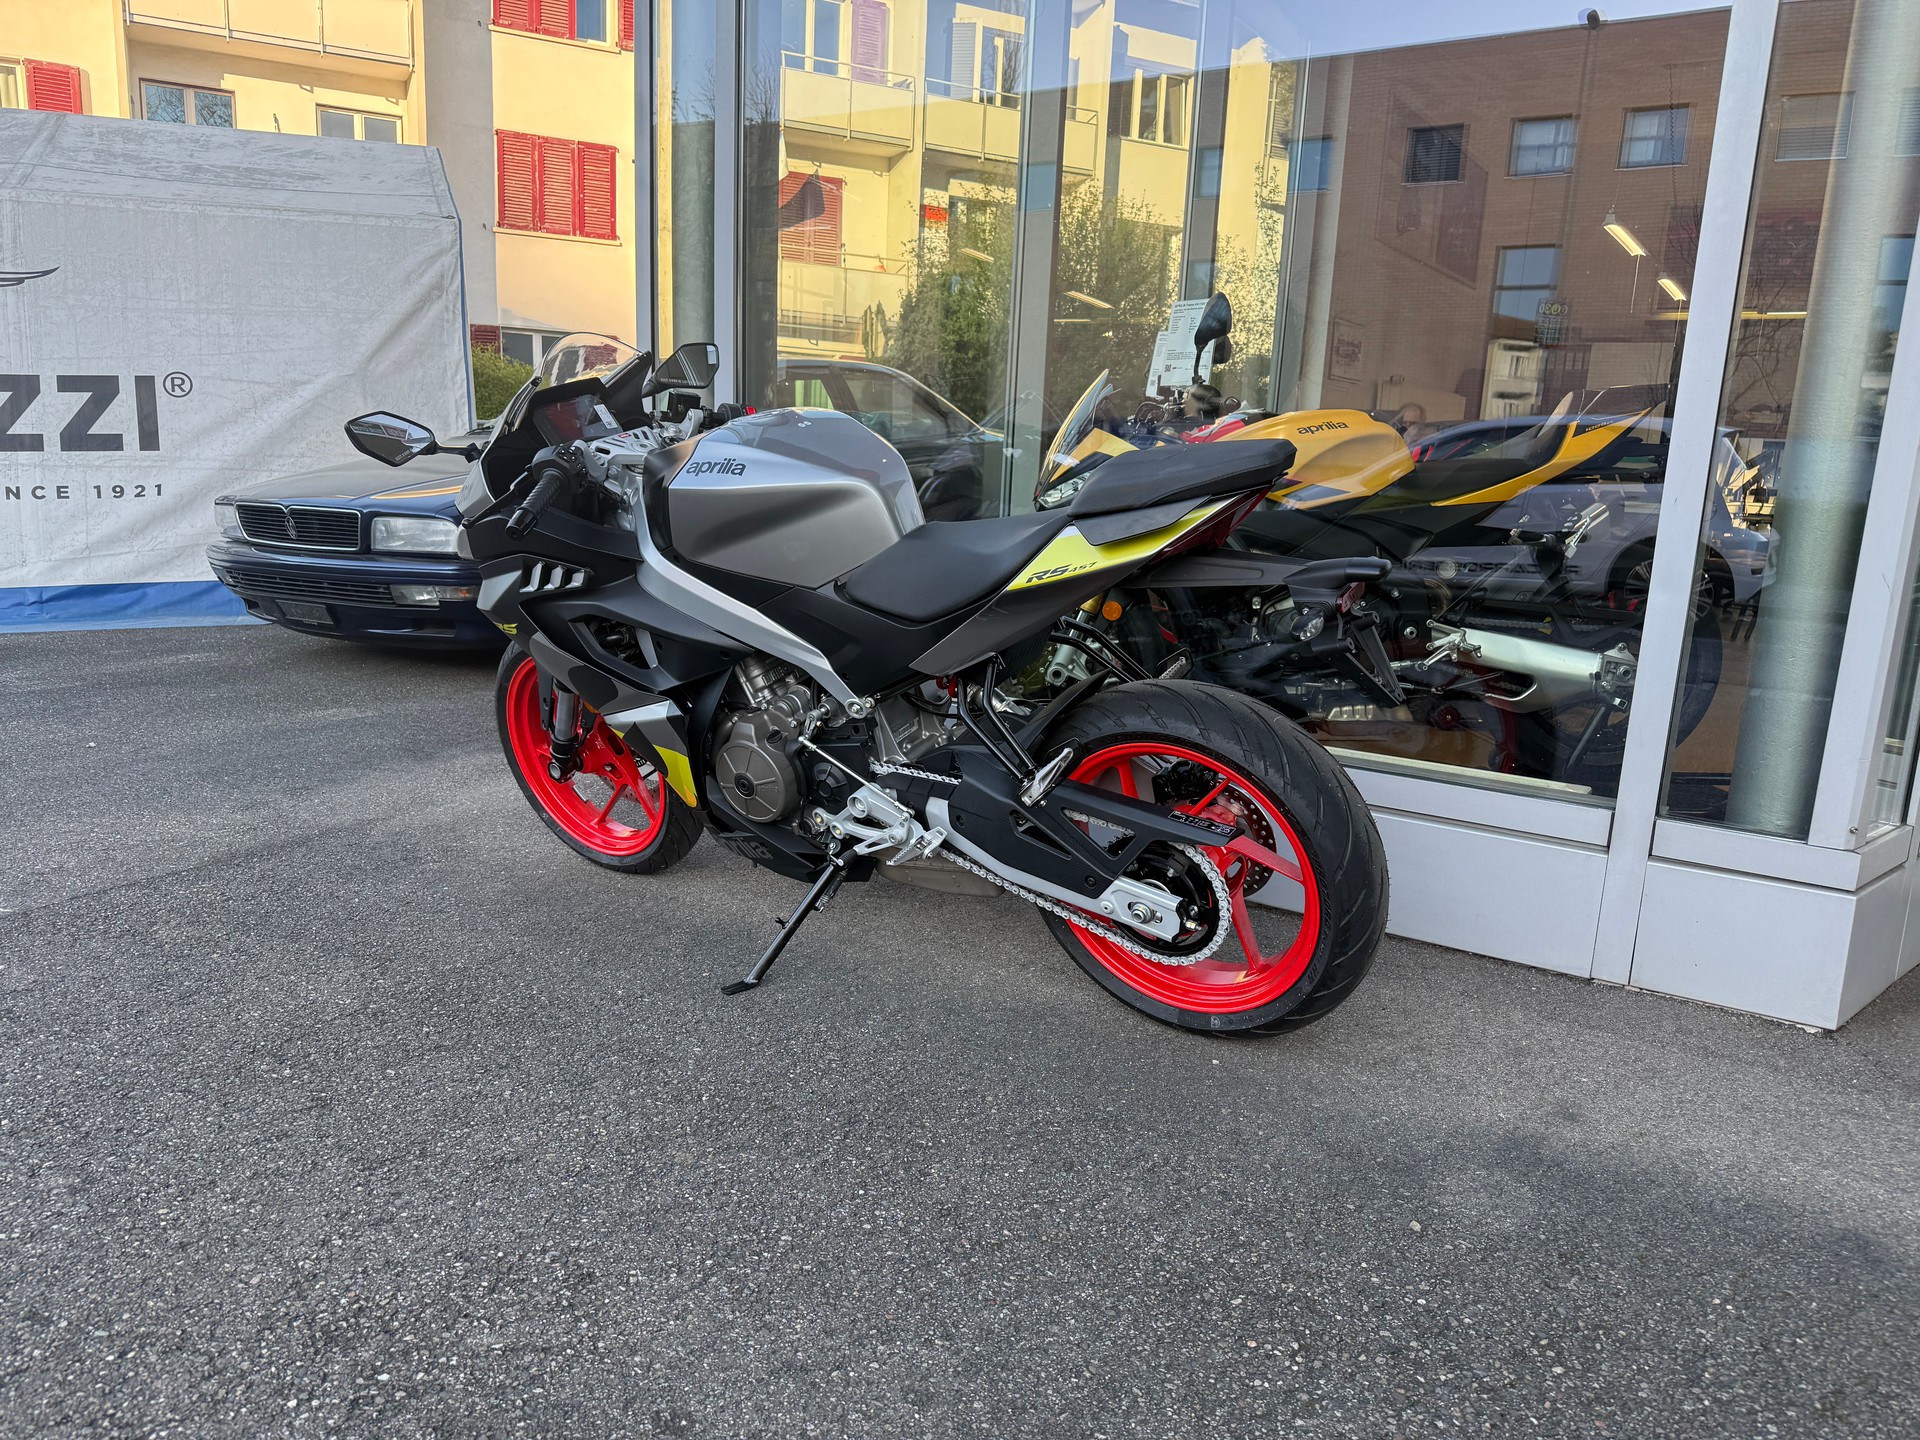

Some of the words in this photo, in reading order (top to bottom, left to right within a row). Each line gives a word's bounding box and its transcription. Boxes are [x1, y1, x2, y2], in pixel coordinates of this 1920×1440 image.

[1296, 421, 1349, 434] aprilia
[686, 458, 747, 477] aprilia
[5, 485, 70, 500] NCE
[93, 484, 163, 499] 1921
[1025, 563, 1073, 584] RS
